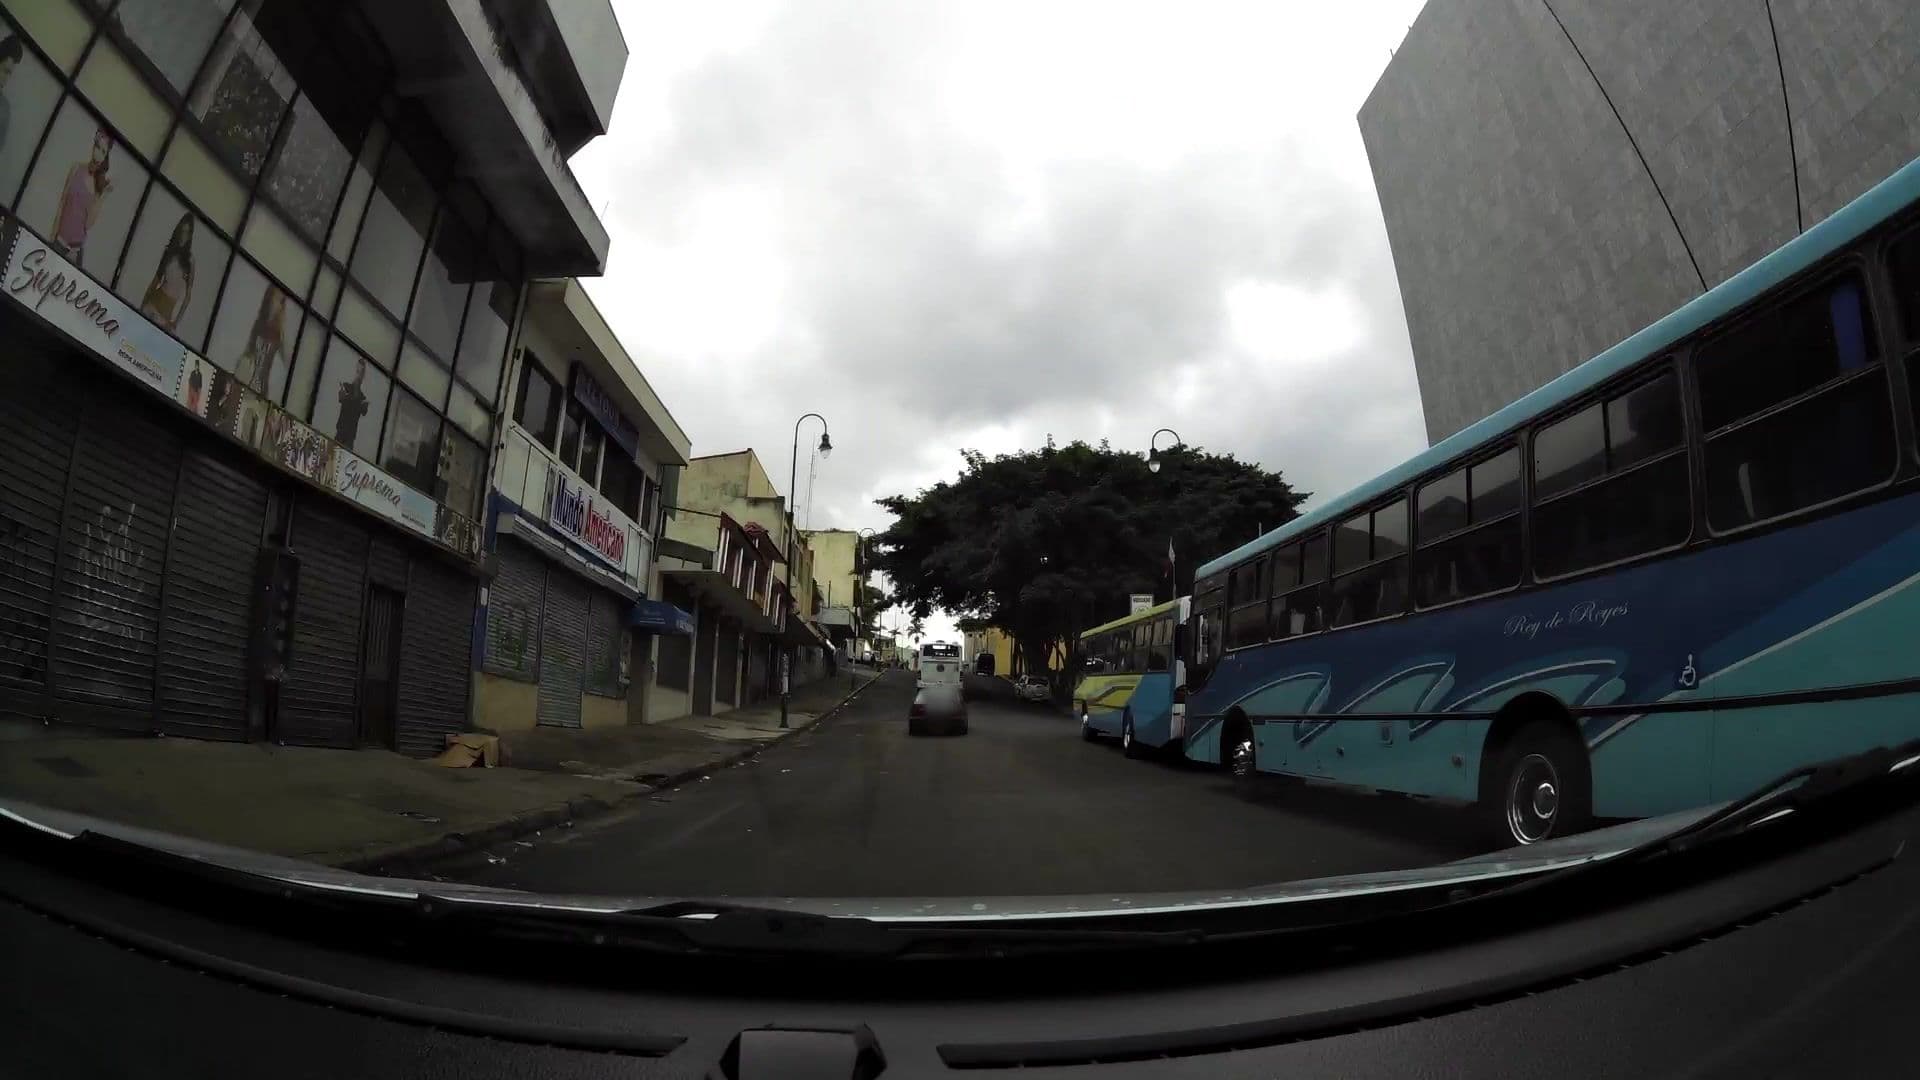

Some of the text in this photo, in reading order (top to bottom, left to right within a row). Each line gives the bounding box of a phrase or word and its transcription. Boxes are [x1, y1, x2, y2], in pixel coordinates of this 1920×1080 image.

[10, 248, 119, 339] Suprema
[340, 458, 401, 507] Suprema
[552, 471, 624, 562] Mundo Americano
[1503, 600, 1628, 640] Rey de Reyes
